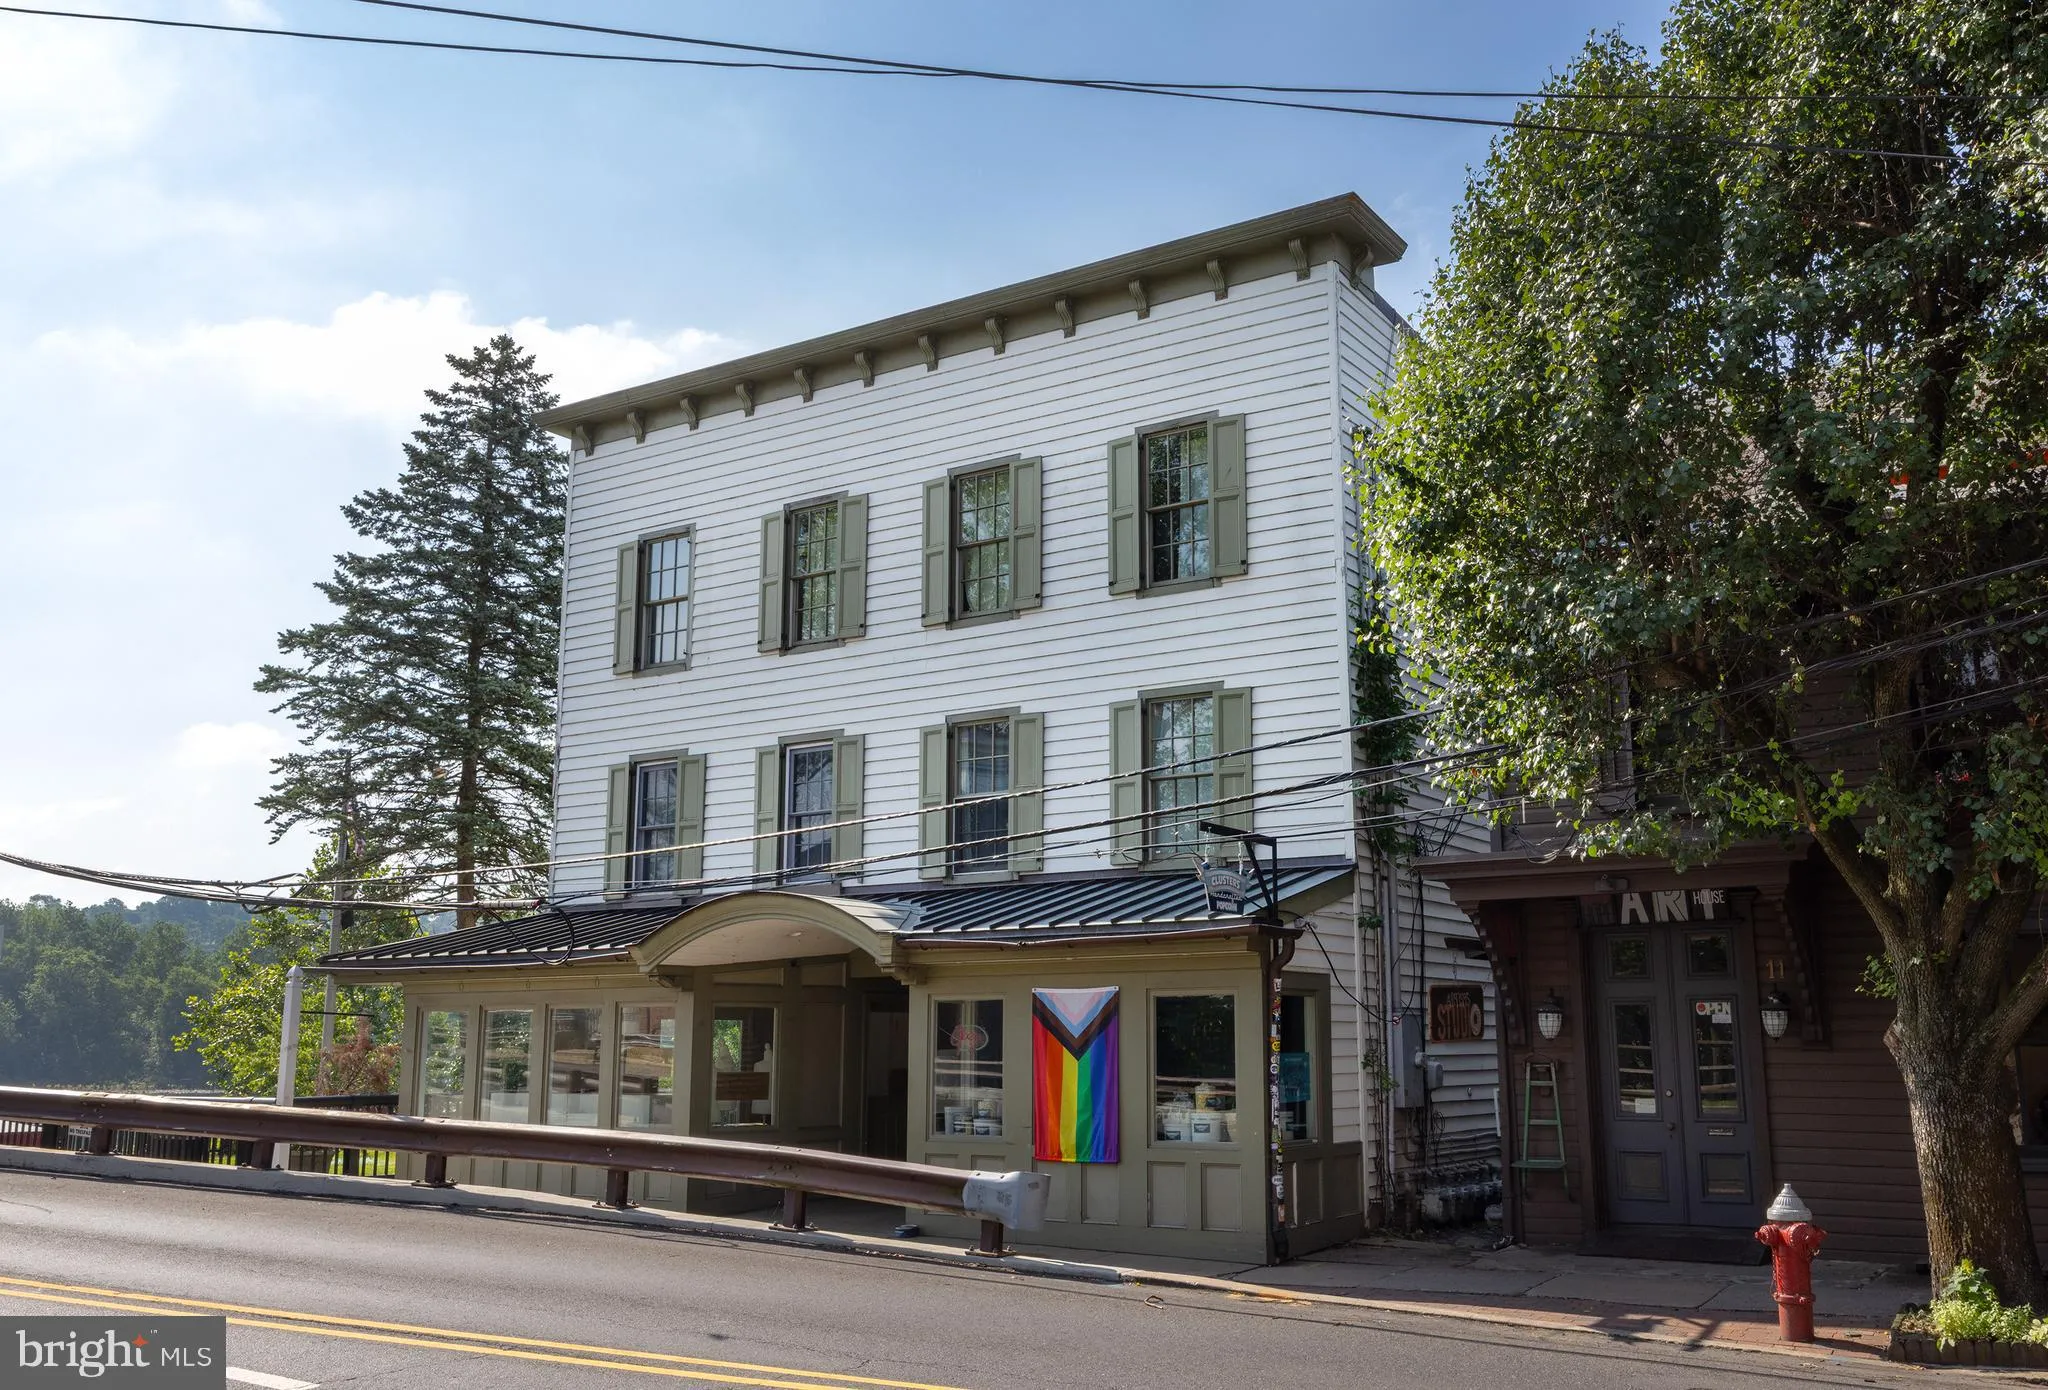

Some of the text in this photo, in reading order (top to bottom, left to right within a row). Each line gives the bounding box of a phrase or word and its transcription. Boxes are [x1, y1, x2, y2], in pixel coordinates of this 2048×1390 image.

[1212, 876, 1241, 889] CLUSTERS
[1692, 890, 1726, 905] HOUSE
[1765, 958, 1785, 979] 11
[1696, 1001, 1731, 1016] OPEN
[1437, 1003, 1482, 1040] STUDIO
